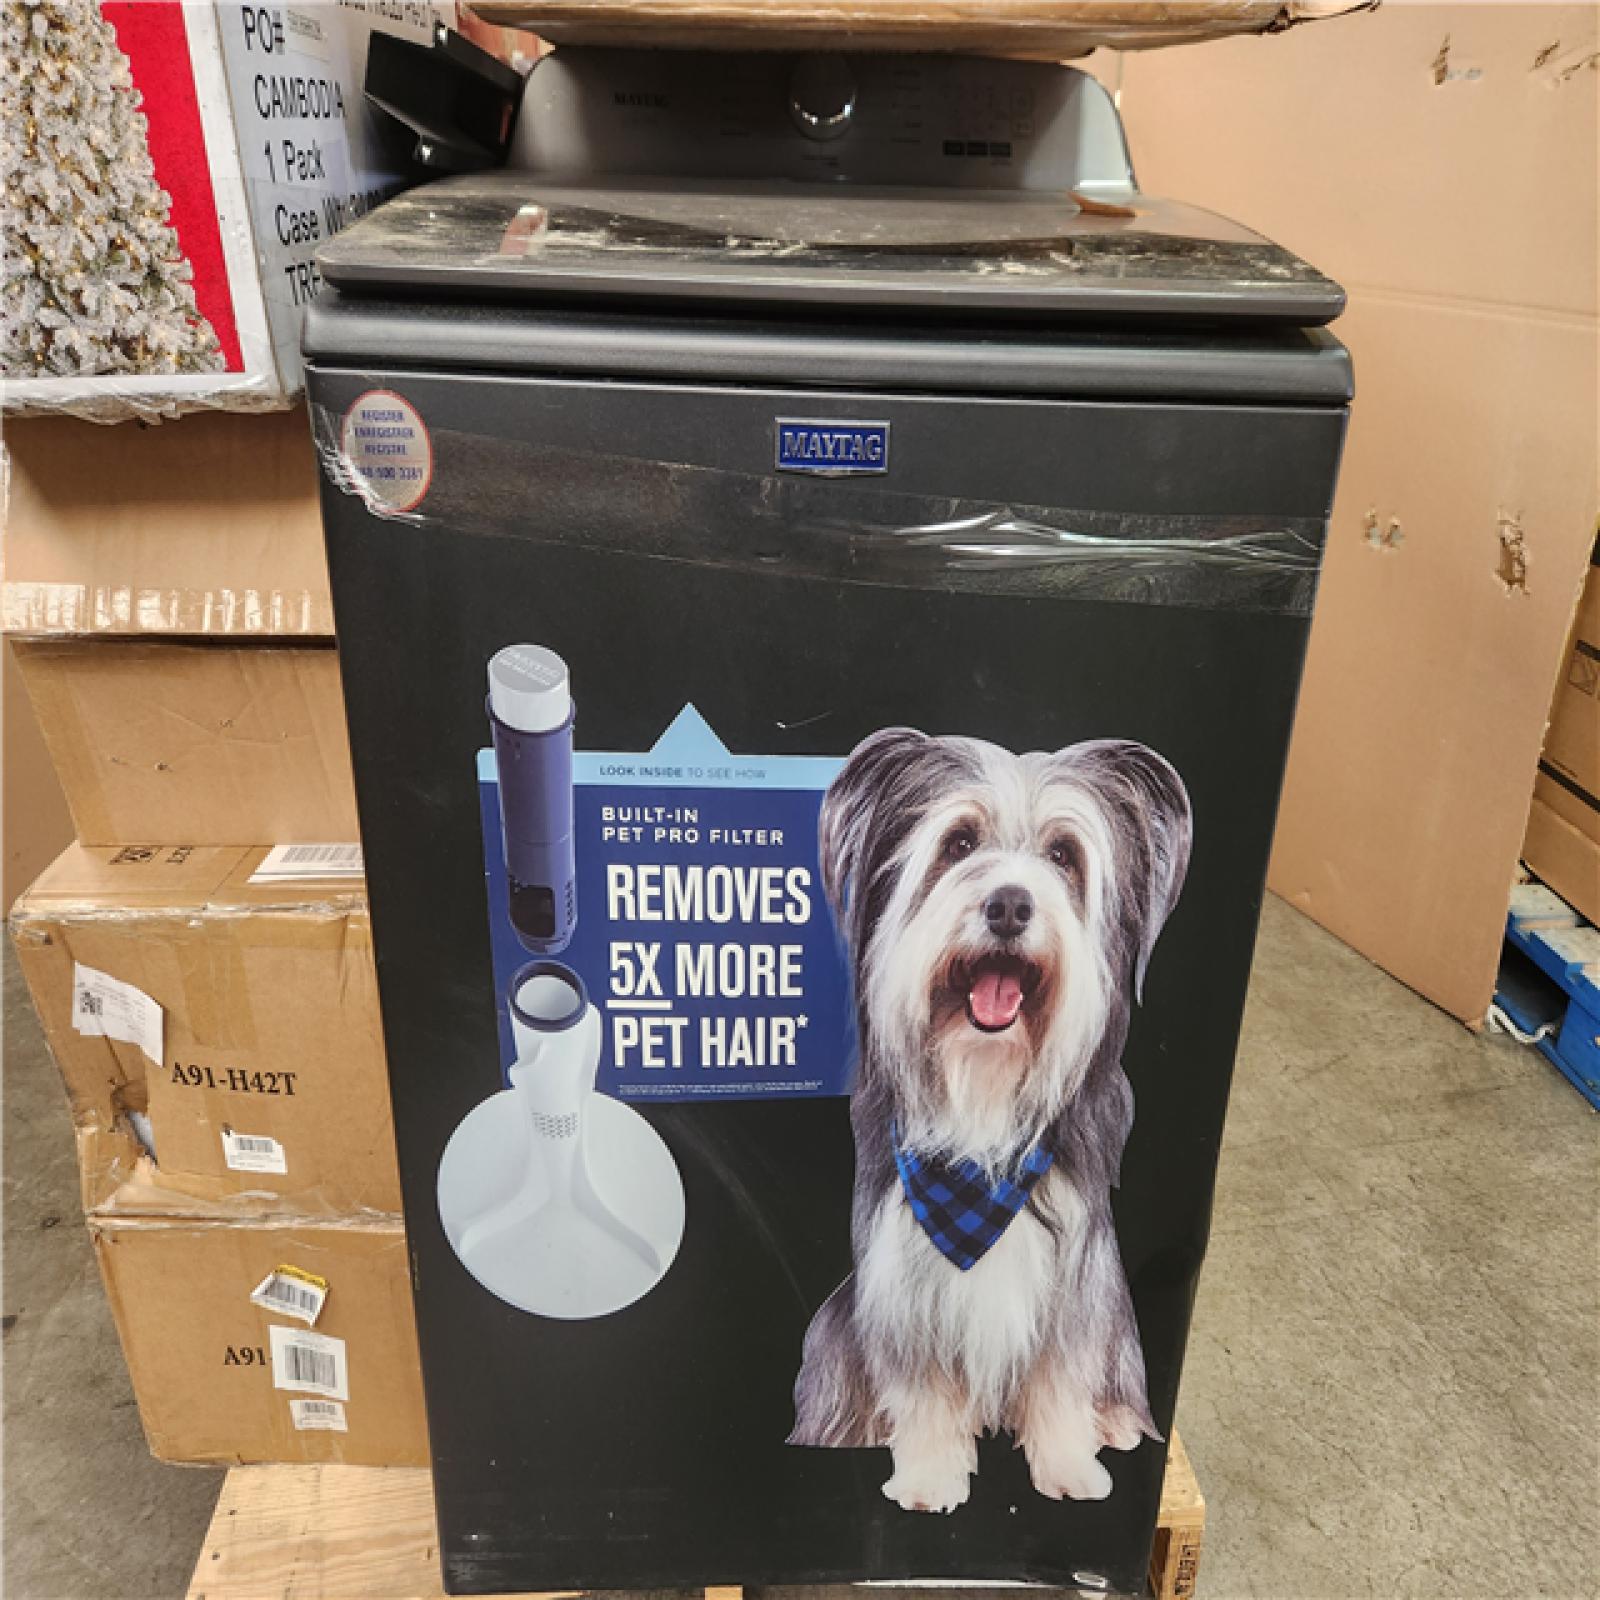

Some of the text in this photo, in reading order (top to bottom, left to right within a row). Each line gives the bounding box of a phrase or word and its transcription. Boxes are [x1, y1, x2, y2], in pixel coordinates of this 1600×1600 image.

[241, 5, 285, 55] PO#
[254, 75, 348, 119] CAMBODIA
[264, 140, 325, 182] 1 Pack
[274, 205, 320, 246] Case
[782, 431, 881, 461] MAYTAG
[600, 765, 767, 779] LOOK INSIDE TO SEE HOW
[602, 807, 698, 823] BUILT-IN
[602, 827, 784, 845] PET PRO FILTER
[607, 864, 811, 924] REMOVES
[609, 942, 804, 997] 5X MORE
[613, 1016, 689, 1068] PET
[172, 1062, 297, 1095] A91-H42T
